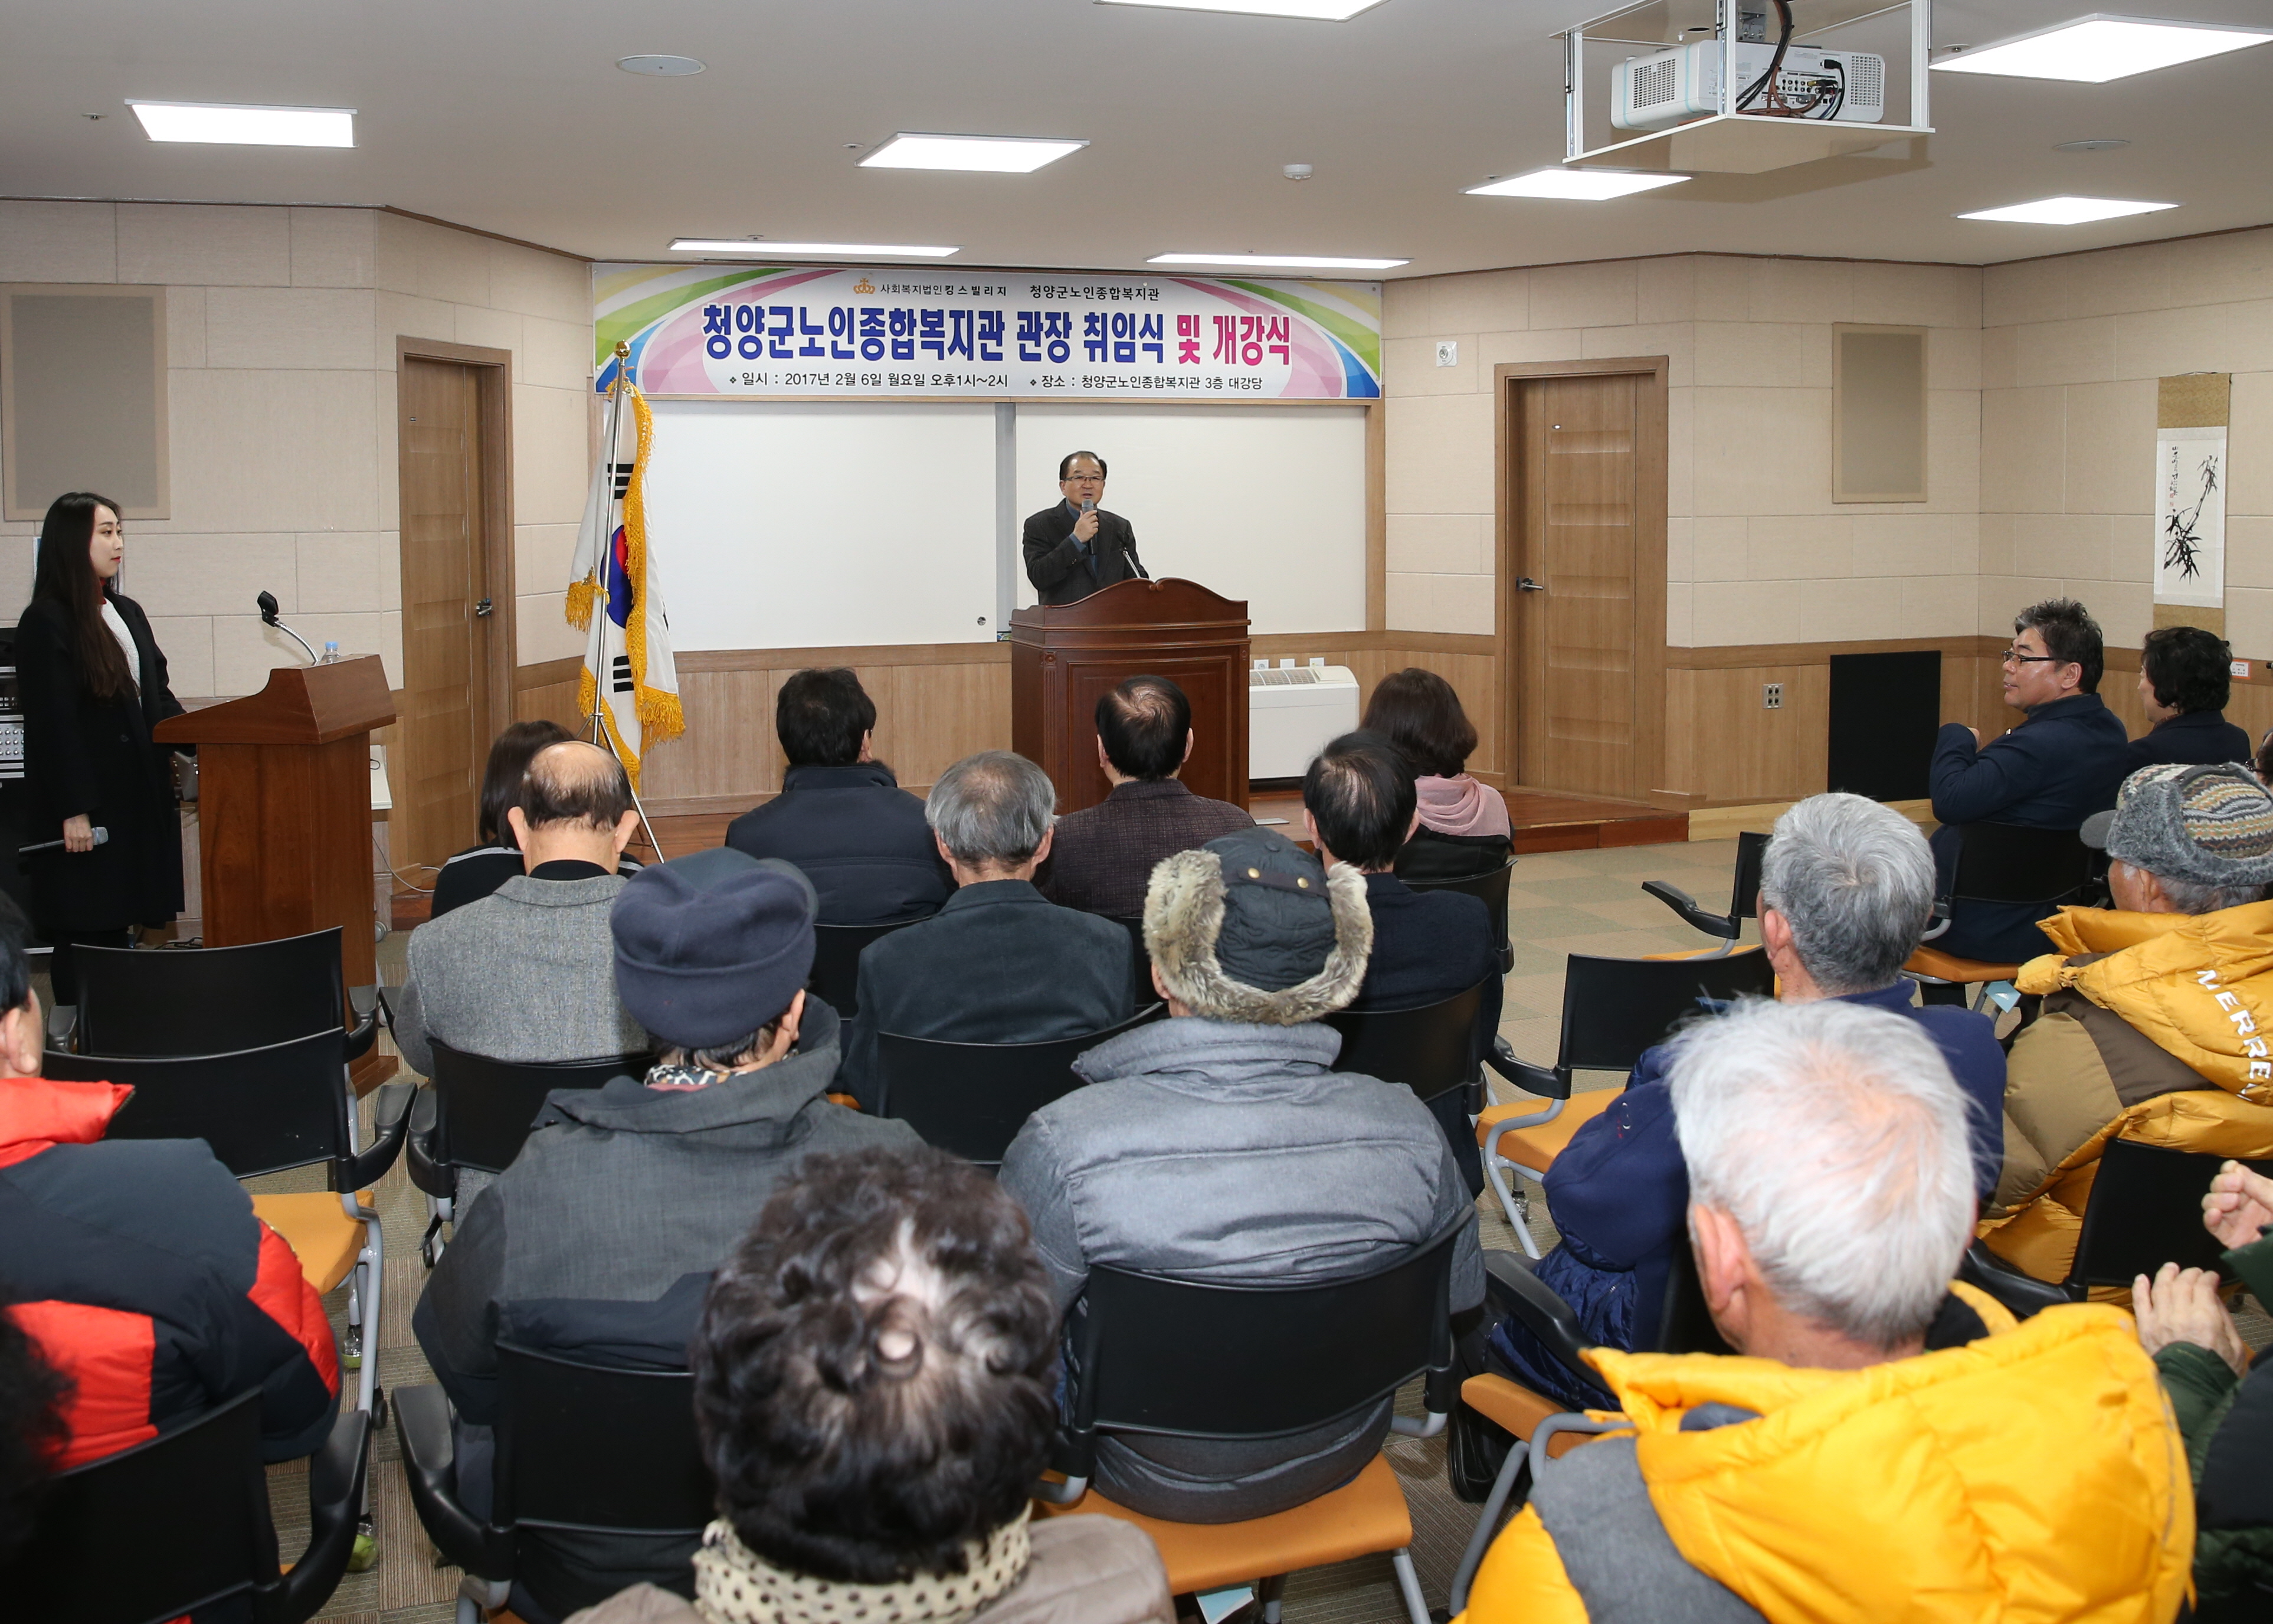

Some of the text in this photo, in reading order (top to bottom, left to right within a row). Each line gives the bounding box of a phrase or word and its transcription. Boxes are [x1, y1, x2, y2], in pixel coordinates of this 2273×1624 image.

[1030, 284, 1160, 301] 청양군노인종합복지관
[702, 303, 1290, 366] 청양군노인종합복지관 관장 취임식 및 개강식
[742, 372, 768, 386] 일시
[784, 372, 830, 386] 2017년
[835, 372, 856, 386] 2월
[860, 372, 882, 387] 6일
[887, 372, 925, 387] 월요일
[1041, 375, 1066, 388] 장소
[1081, 375, 1201, 389] 청양군노인종합복지관
[1204, 376, 1224, 390] 3층
[1229, 376, 1263, 390] 대강당
